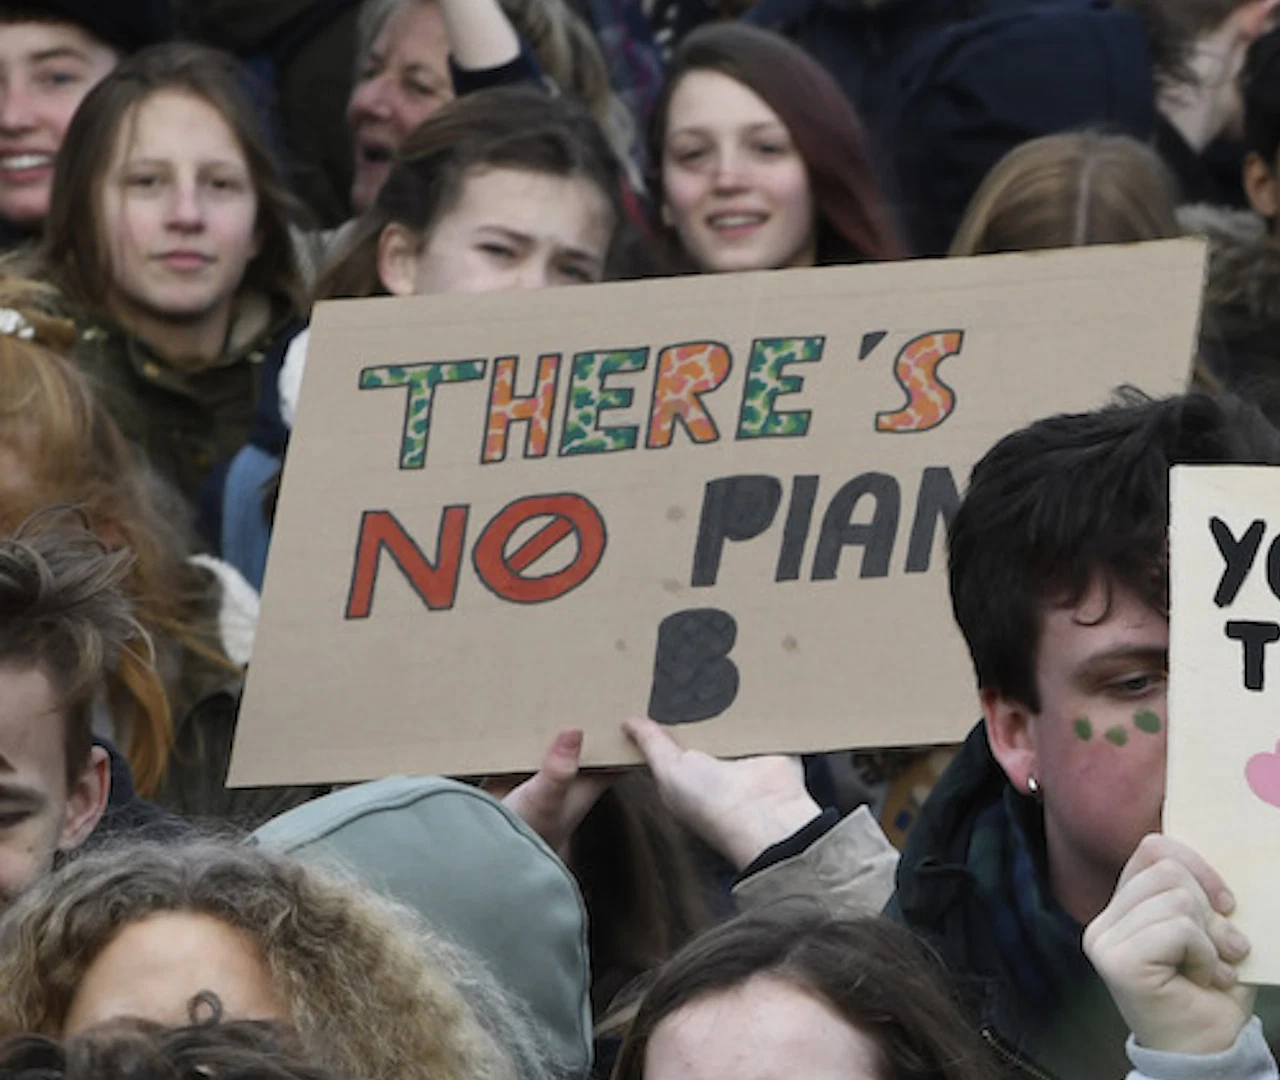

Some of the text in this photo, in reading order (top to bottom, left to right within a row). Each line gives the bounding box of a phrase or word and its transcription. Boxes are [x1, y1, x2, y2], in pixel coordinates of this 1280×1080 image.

[359, 330, 964, 469] THERE'S
[345, 493, 607, 619] NO
[648, 608, 741, 726] B
